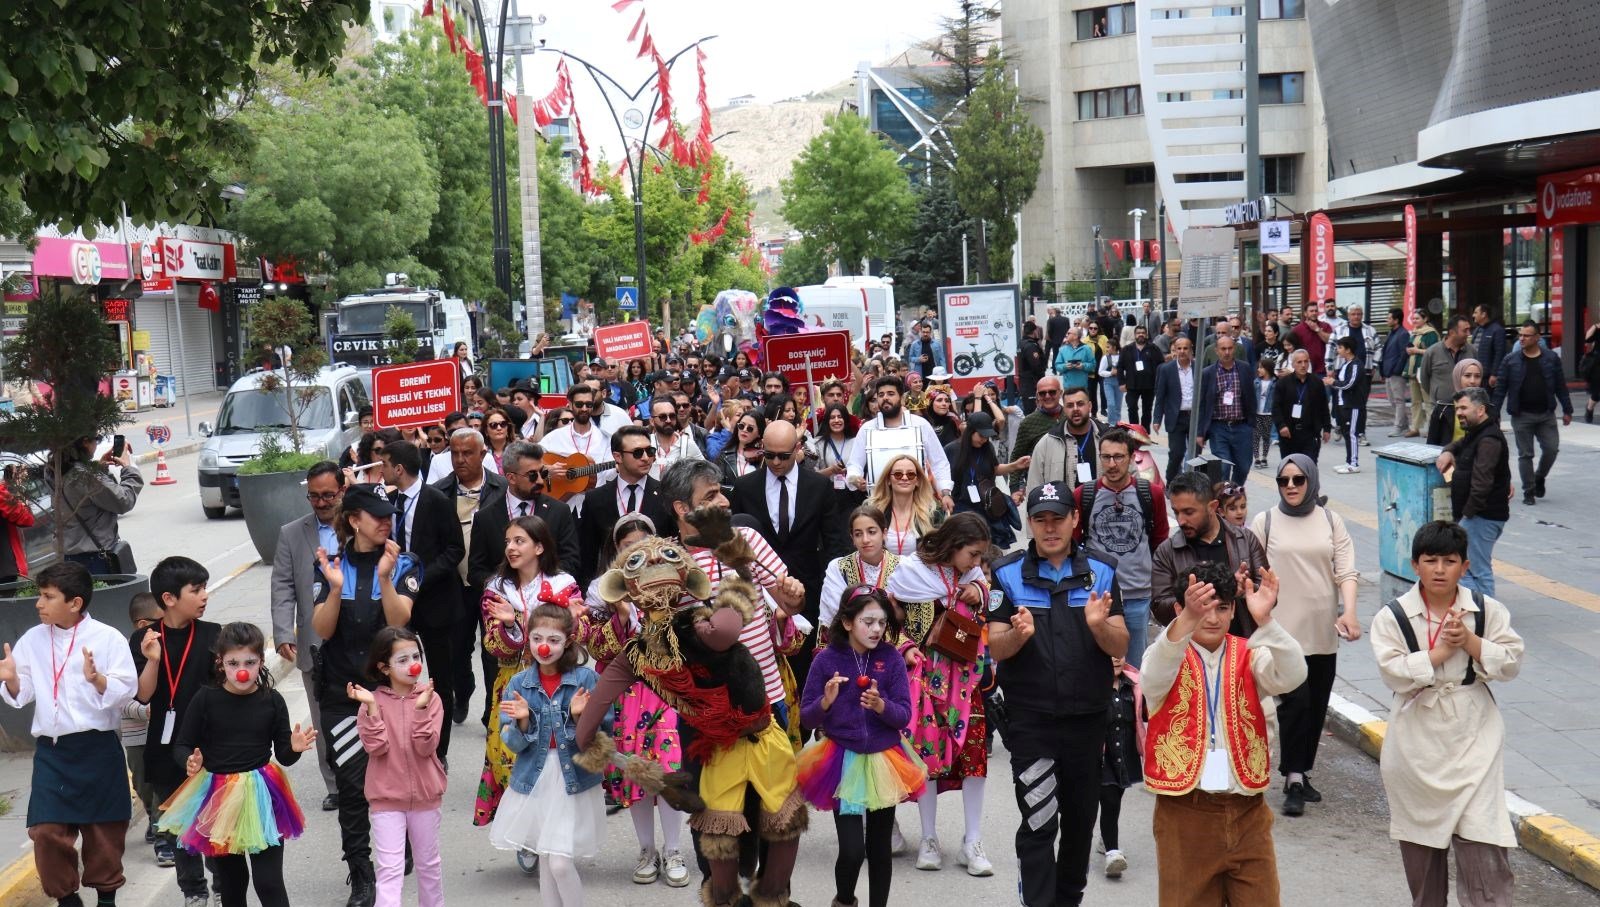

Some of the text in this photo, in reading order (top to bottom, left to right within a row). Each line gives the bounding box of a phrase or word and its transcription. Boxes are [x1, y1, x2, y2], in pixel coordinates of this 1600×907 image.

[1556, 187, 1592, 208] vodafone
[1225, 201, 1260, 225] BROMPTON
[1406, 214, 1416, 325] vodafone
[333, 337, 432, 352] ÇEVİK KUET
[605, 340, 643, 352] ANADOLU LİSESİ
[788, 347, 826, 359] BOSTANİÇİ
[777, 358, 839, 372] TOPLUM MERKEZİ
[400, 374, 431, 387] EDREMİT
[381, 386, 452, 404] MESLEKİ VE TEKNİK
[388, 401, 446, 418] ANADOLU LİSESİ
